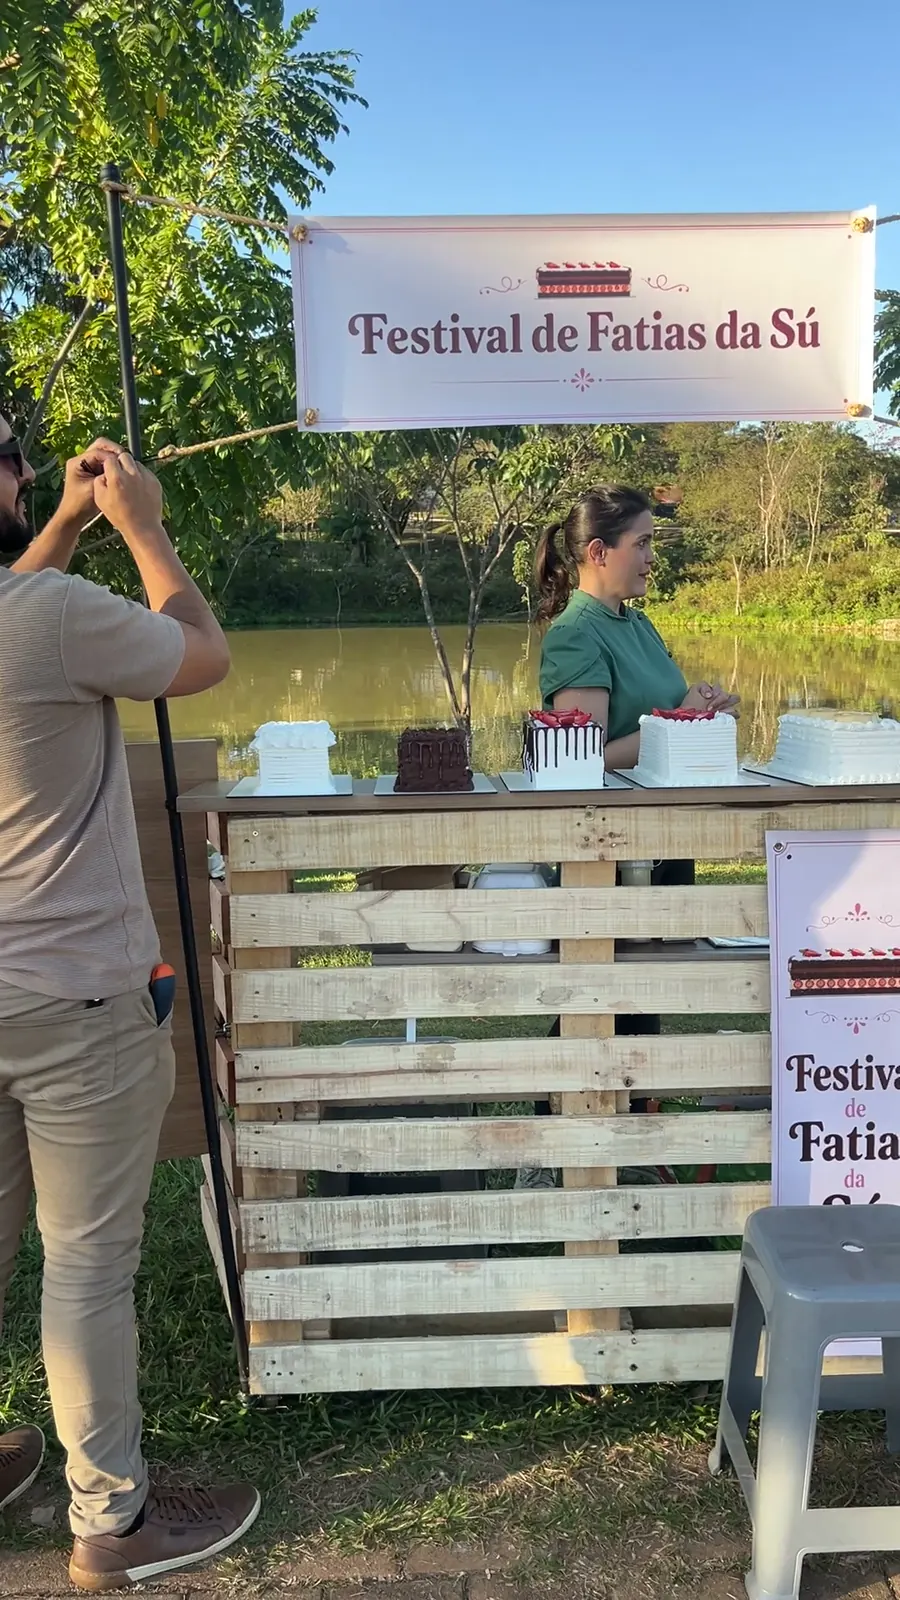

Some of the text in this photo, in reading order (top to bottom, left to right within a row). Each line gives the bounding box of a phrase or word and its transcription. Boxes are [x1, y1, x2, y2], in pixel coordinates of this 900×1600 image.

[347, 306, 821, 355] Festival de Fatias da Sú
[844, 1097, 867, 1118] de
[844, 1168, 865, 1189] da
